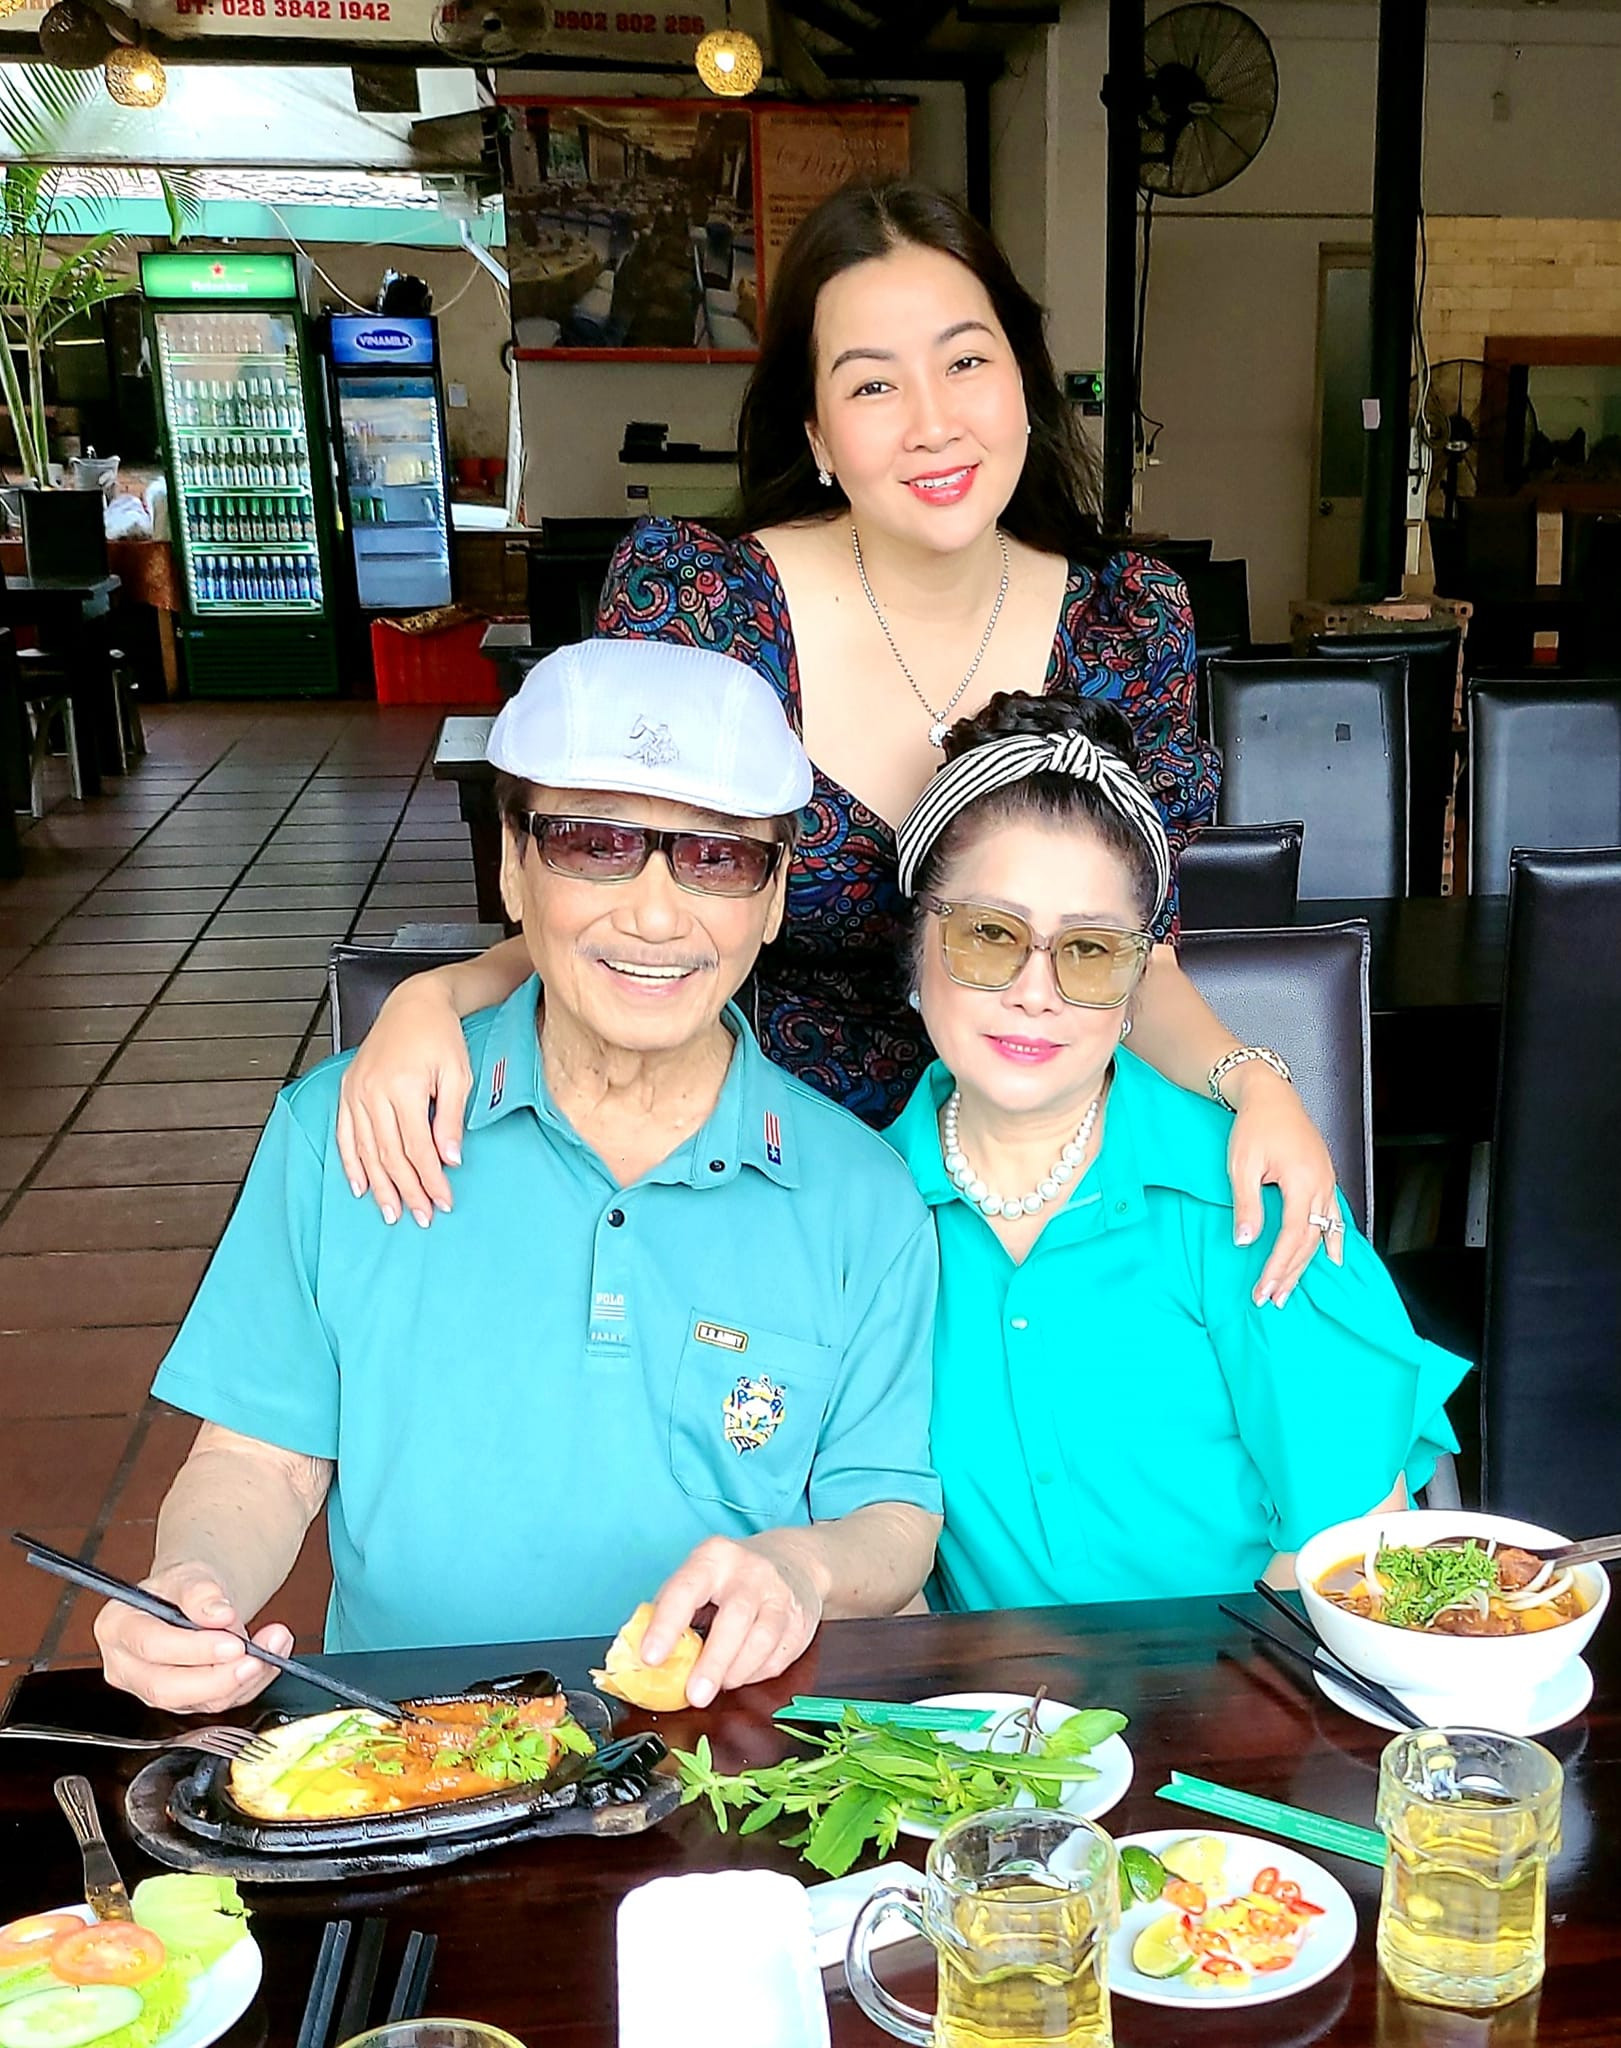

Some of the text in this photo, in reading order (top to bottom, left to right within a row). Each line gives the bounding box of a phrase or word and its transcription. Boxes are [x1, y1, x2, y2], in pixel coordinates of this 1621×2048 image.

[222, 0, 266, 16] 028
[274, 0, 331, 19] 3842
[339, 1, 391, 21] 1942
[358, 335, 411, 347] VINAMILK
[595, 1292, 625, 1305] POLO
